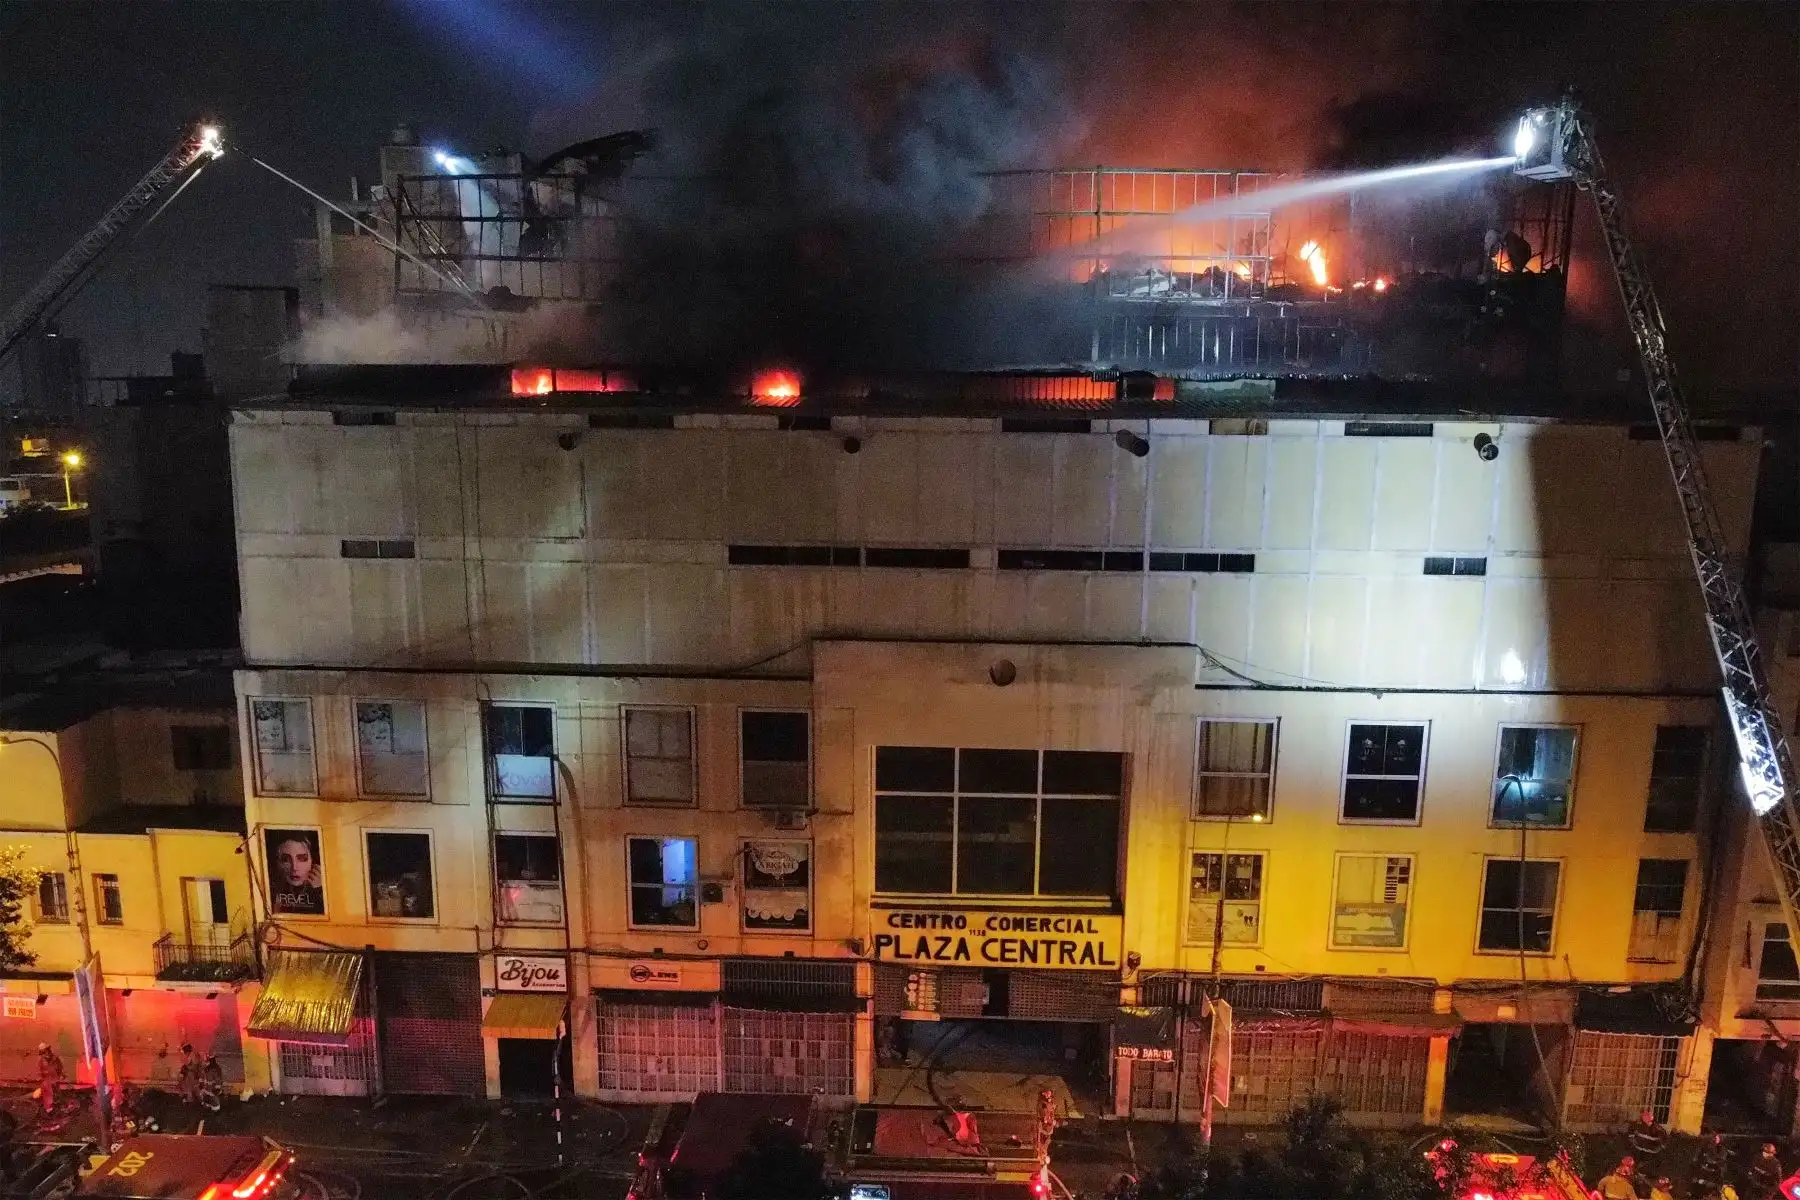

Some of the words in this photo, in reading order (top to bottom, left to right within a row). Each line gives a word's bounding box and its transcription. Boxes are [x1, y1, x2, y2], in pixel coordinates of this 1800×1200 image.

[887, 913, 967, 931] CENTRO
[985, 916, 1099, 934] COMERCIAL
[875, 934, 971, 961] PLAZA
[981, 937, 1116, 966] CENTRAL
[1118, 1046, 1139, 1058] TODO
[1142, 1048, 1173, 1060] BARATO
